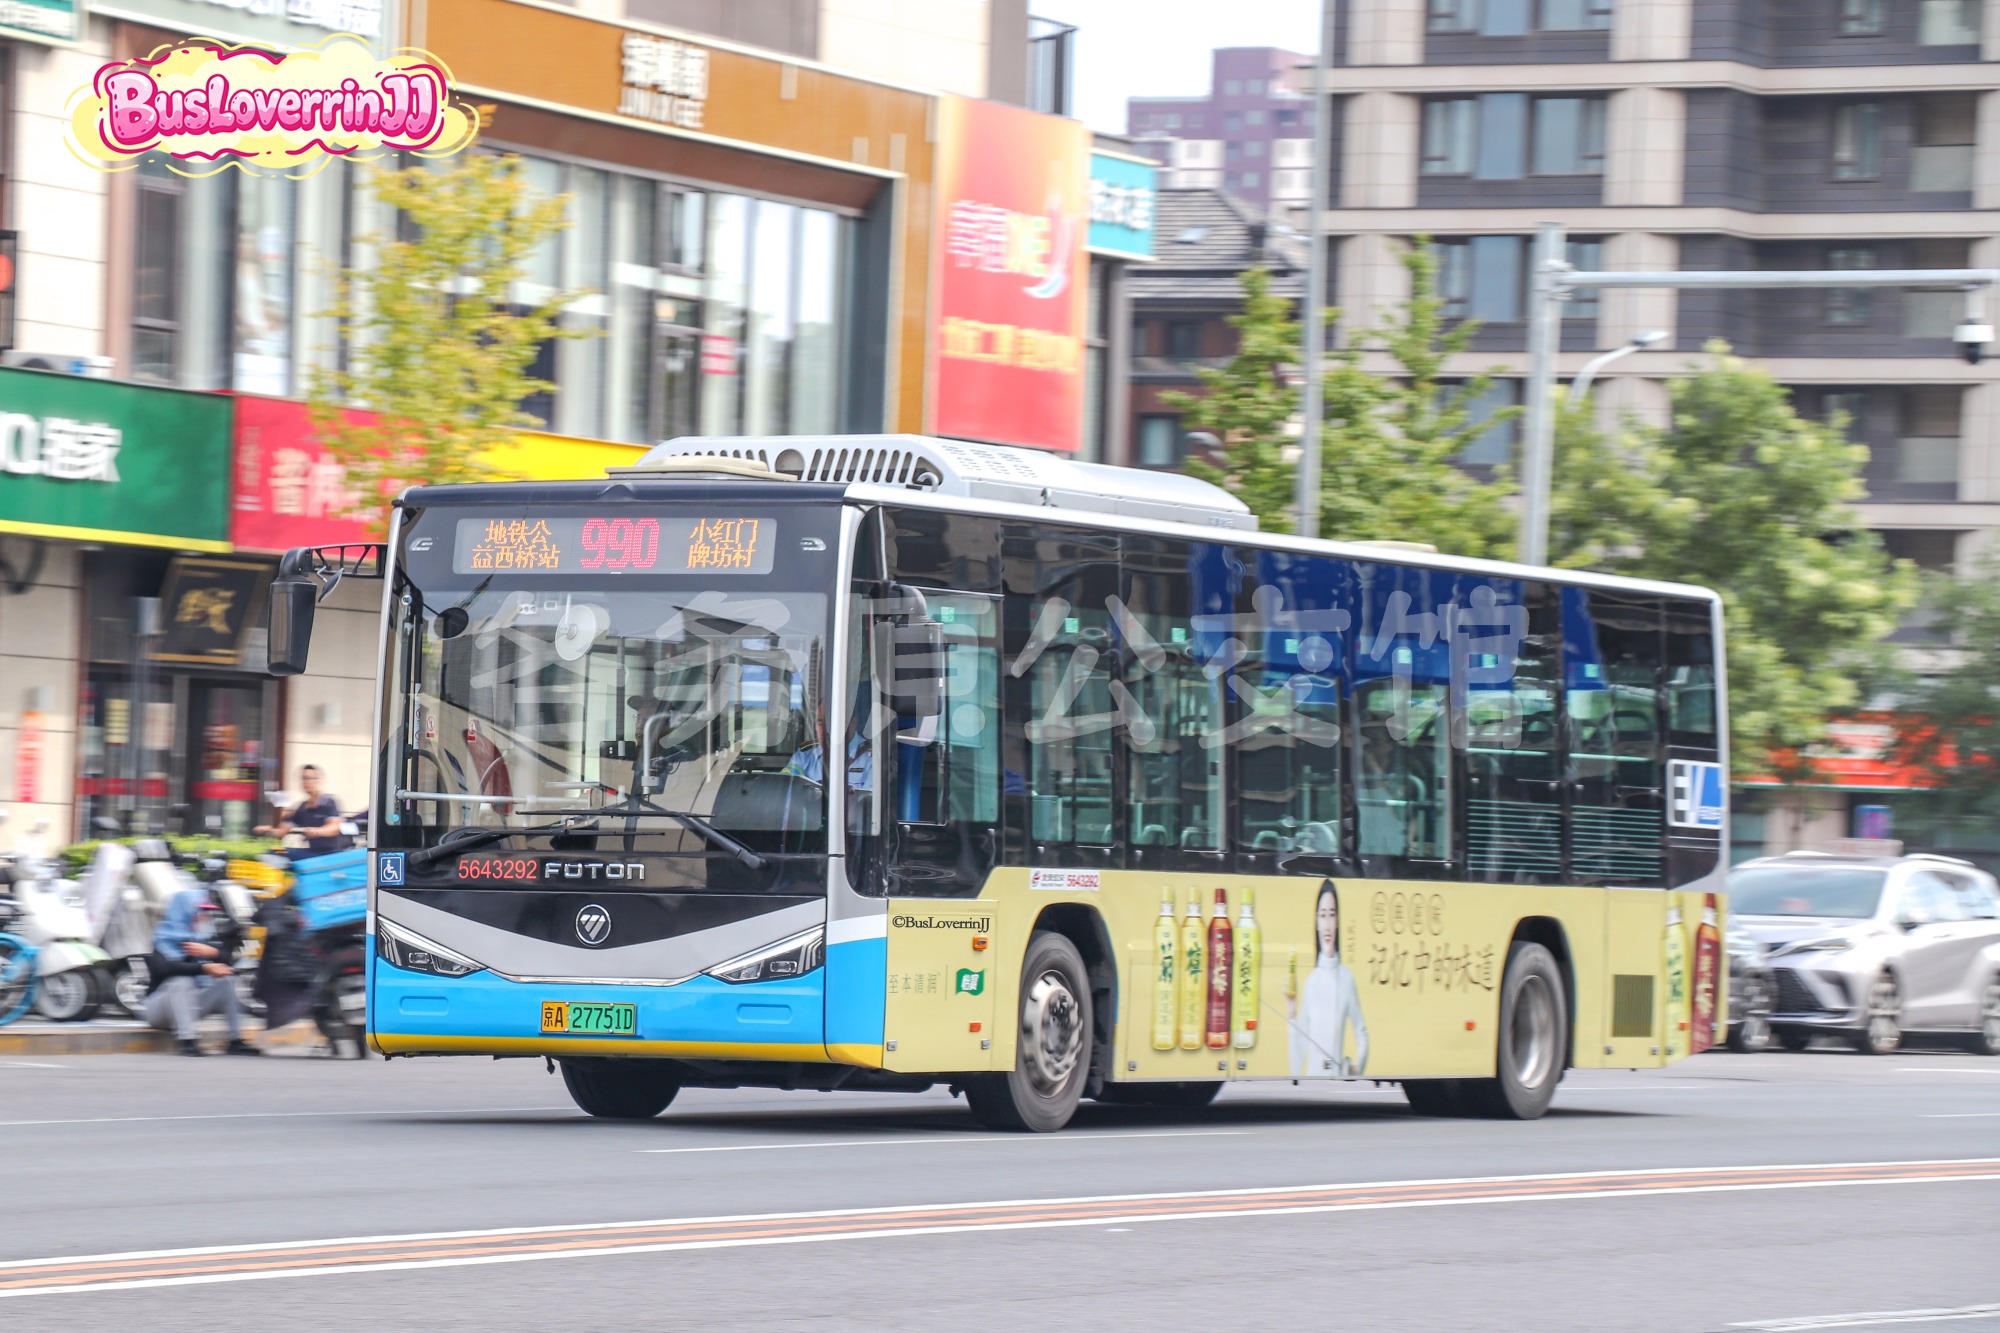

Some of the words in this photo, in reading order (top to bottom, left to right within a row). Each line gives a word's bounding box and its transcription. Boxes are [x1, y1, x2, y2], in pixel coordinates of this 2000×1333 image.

[484, 520, 552, 545] 地铁公
[580, 518, 660, 569] 990
[690, 518, 759, 544] 小红门
[471, 545, 559, 569] 益西桥站
[687, 544, 756, 569] 牌坊村
[458, 859, 538, 880] 5643292
[544, 862, 645, 880] FOTON
[1368, 939, 1495, 995] 记忆中的味道
